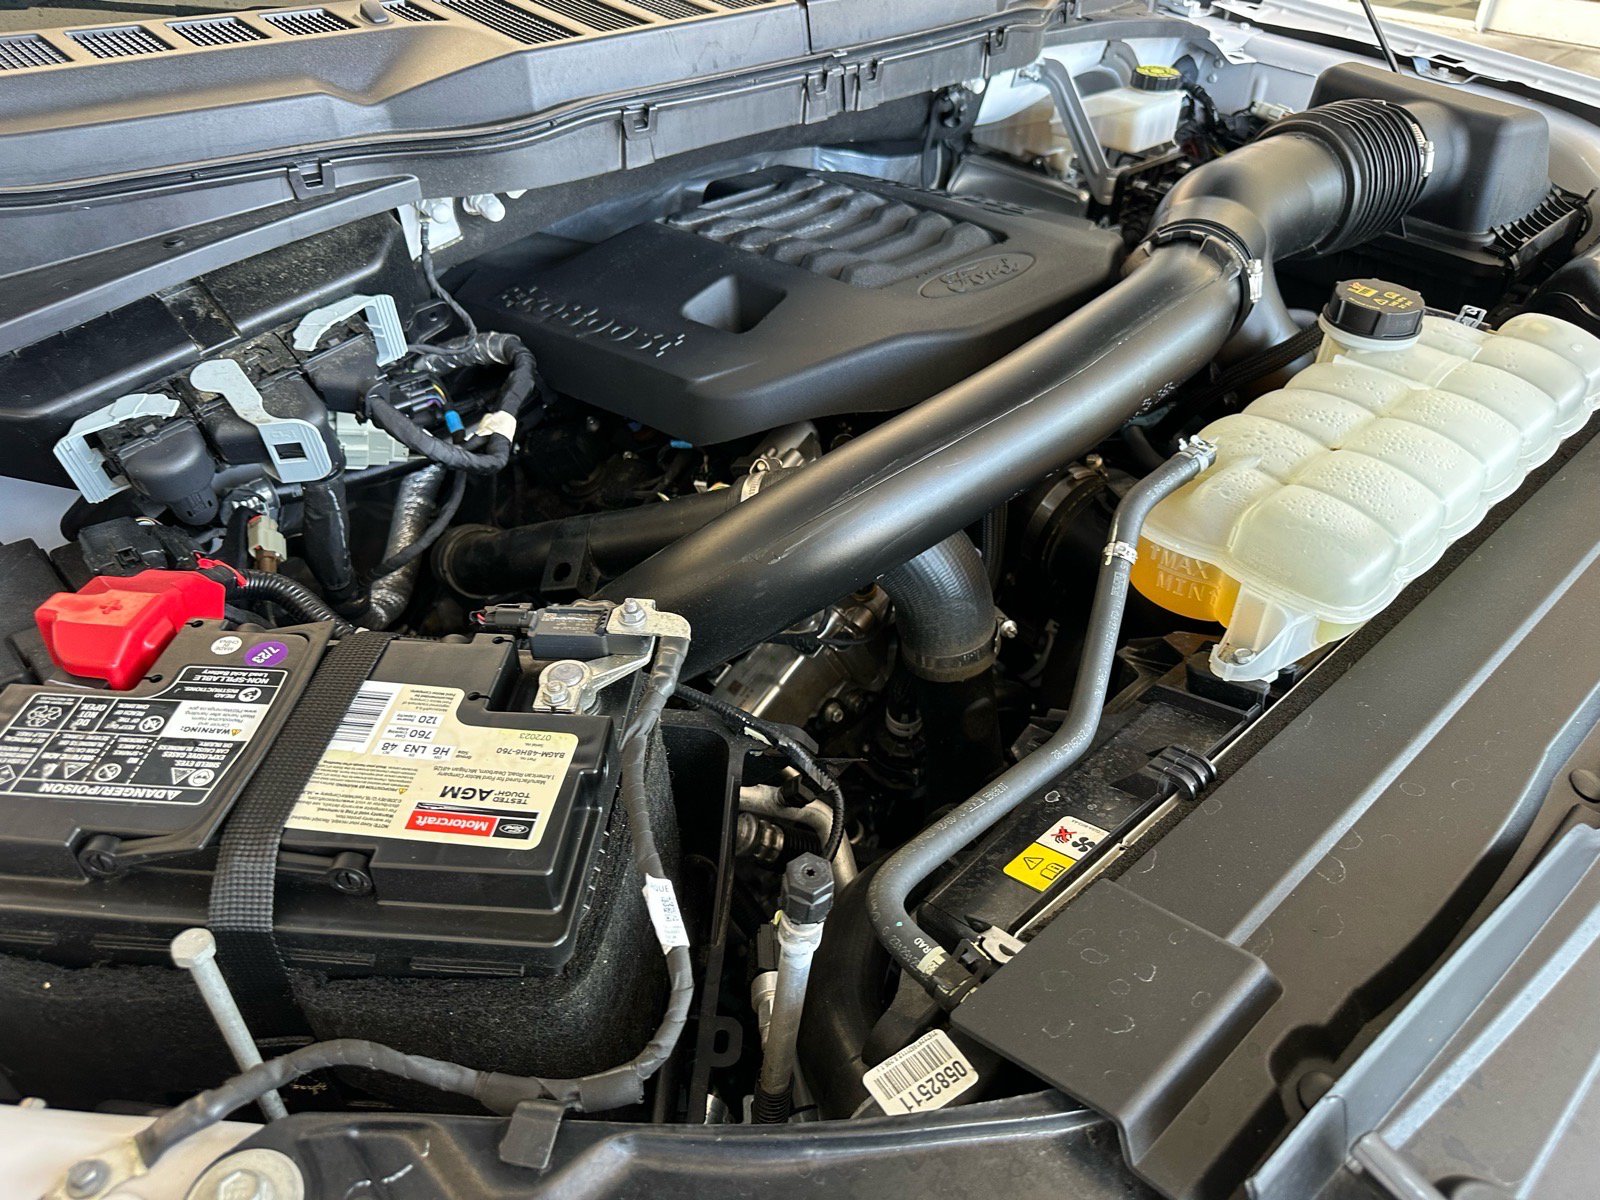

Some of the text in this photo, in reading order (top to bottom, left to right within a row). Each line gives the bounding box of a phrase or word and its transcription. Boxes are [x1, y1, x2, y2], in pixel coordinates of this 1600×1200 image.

[937, 257, 1023, 295] Ford
[1160, 550, 1208, 580] MAX
[1155, 570, 1204, 601] MIN
[191, 674, 270, 683] NON-SPILLABLE
[76, 710, 99, 718] NOT
[416, 715, 439, 724] 120
[178, 726, 232, 734] WARNING:
[407, 729, 433, 739] 760
[518, 731, 552, 741] 072023
[380, 742, 450, 755] H6 LN3 48
[495, 745, 565, 759] BAGM-48H6-760
[184, 752, 226, 760] EXPLOSIVE
[436, 770, 465, 778] Company
[450, 765, 477, 774] Michigan
[505, 776, 546, 785] Manufactured
[38, 782, 168, 799] DANGER/POISON
[438, 784, 494, 802] AGM
[491, 795, 528, 804] TESTED
[414, 814, 528, 834] Ford Motorcraft
[912, 935, 932, 954] RAD
[899, 1060, 967, 1112] 0582511
